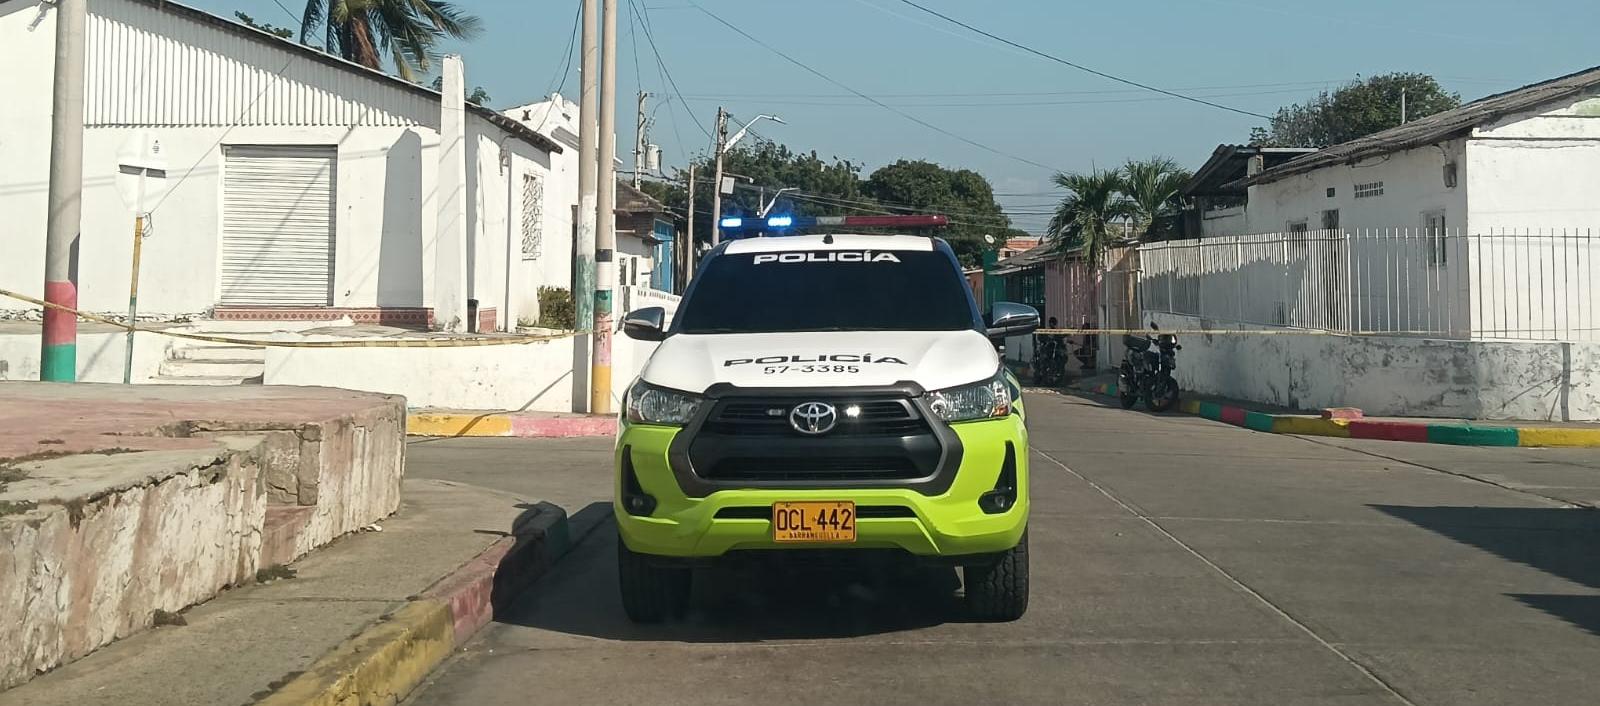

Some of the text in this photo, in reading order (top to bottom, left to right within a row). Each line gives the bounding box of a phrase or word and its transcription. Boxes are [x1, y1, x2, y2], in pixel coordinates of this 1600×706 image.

[754, 250, 901, 264] POLICÍA
[724, 353, 908, 366] POLICÍA
[763, 365, 860, 374] 57-3385
[777, 508, 852, 531] OCL 442
